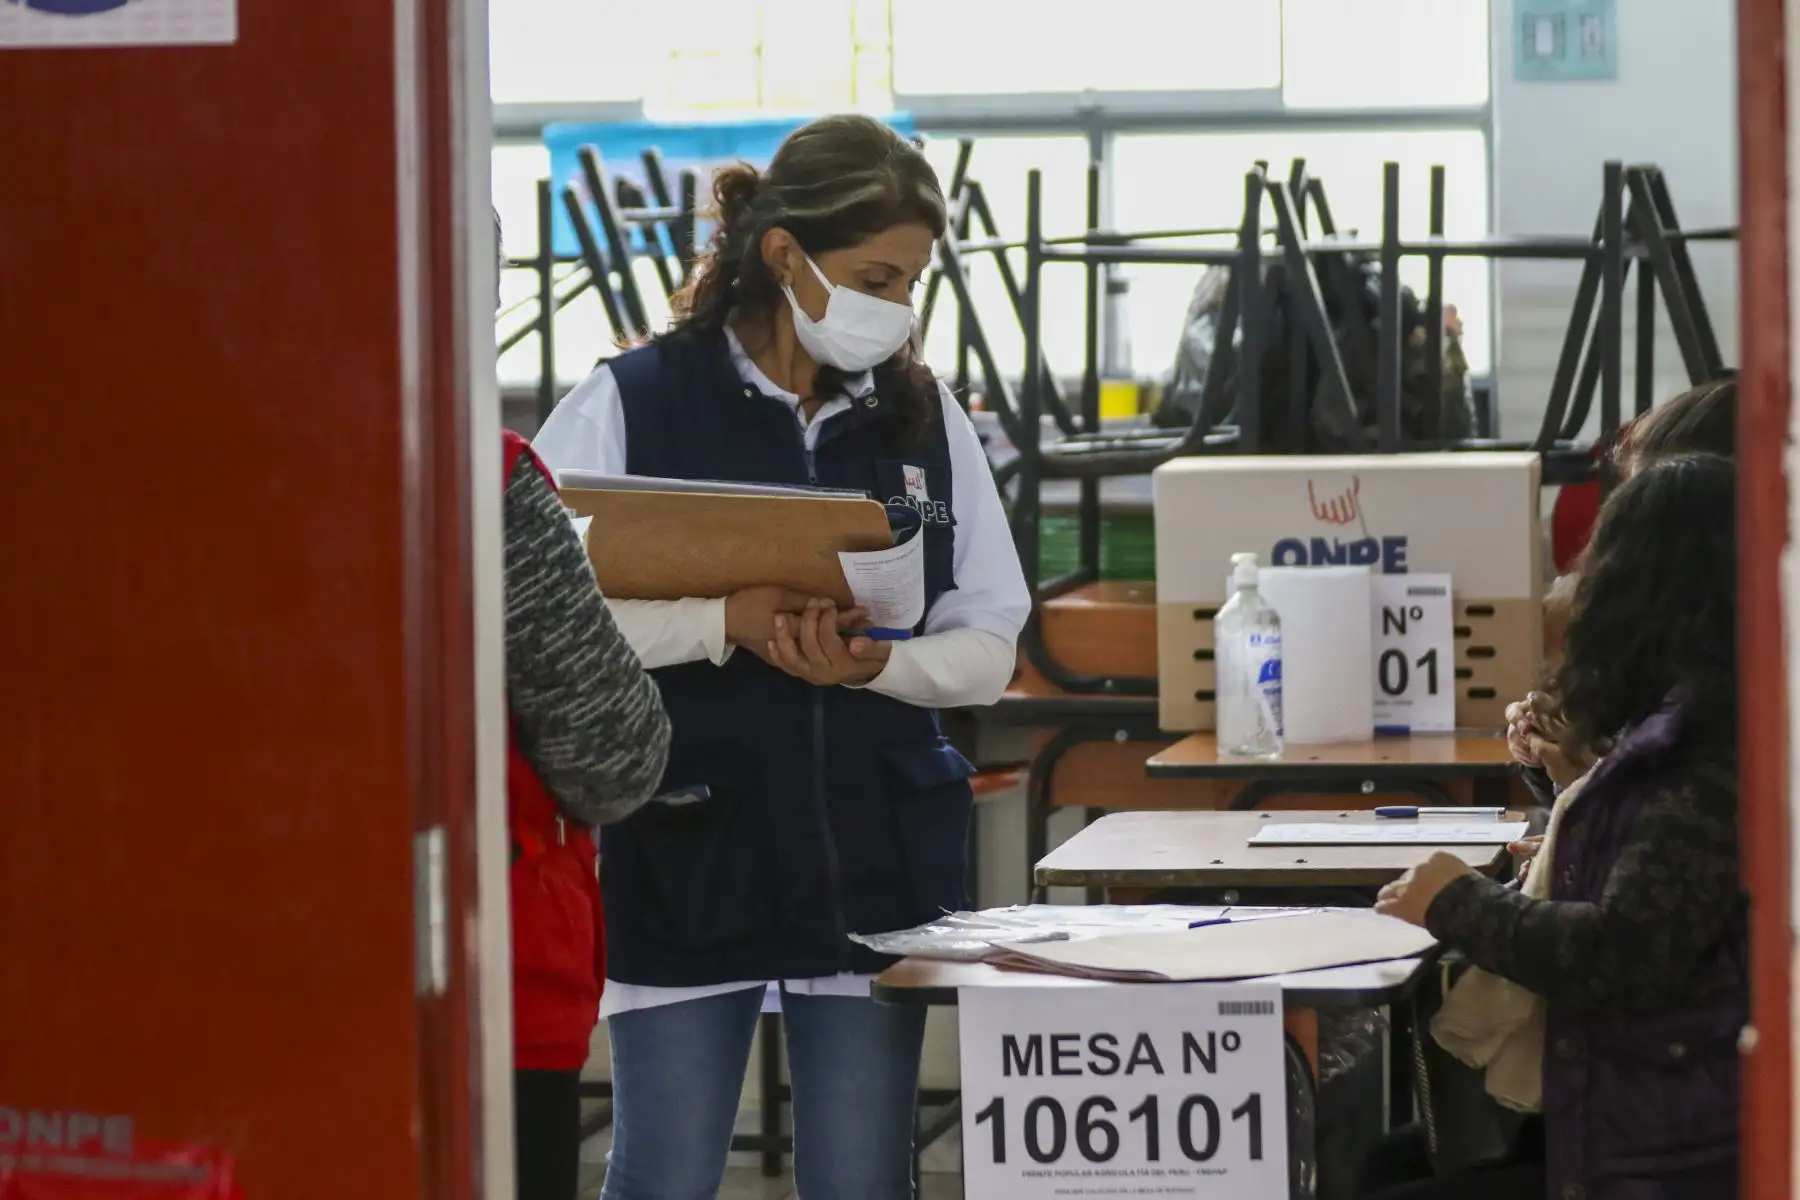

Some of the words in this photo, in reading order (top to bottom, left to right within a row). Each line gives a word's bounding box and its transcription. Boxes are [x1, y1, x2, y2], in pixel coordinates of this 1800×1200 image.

[1271, 535, 1408, 574] ONPE
[1382, 605, 1424, 636] Nº
[1378, 648, 1439, 696] 01
[1002, 1032, 1165, 1077] MESA
[1181, 1030, 1241, 1075] Nº
[975, 1092, 1263, 1164] 106101
